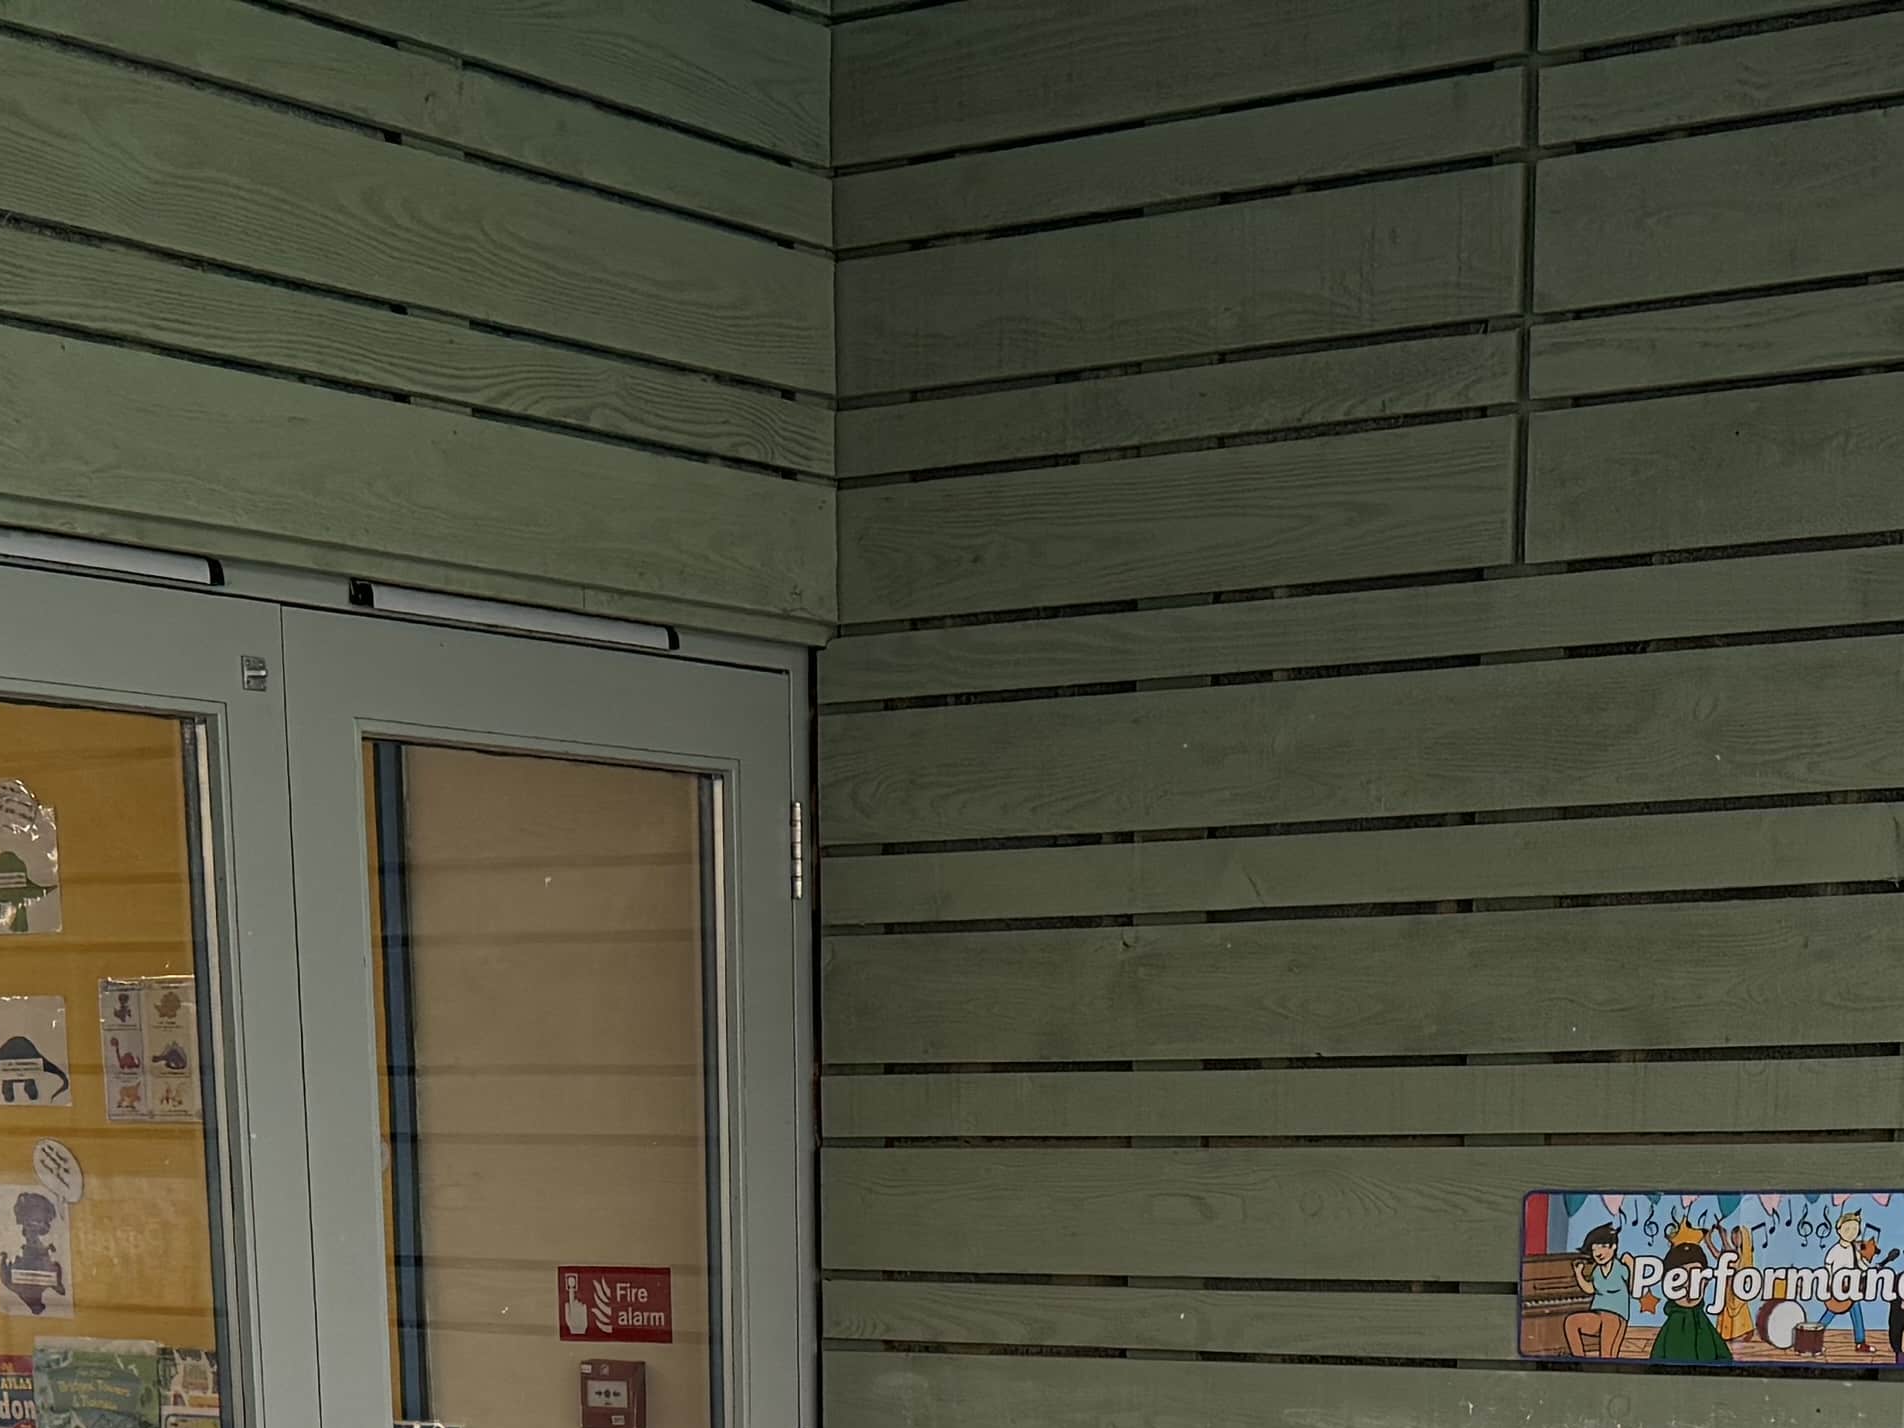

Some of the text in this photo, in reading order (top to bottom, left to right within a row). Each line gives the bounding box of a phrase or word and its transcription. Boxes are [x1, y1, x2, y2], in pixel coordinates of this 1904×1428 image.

[616, 1283, 648, 1302] Fire
[618, 1307, 665, 1327] alarm
[0, 1377, 33, 1391] ATLAS
